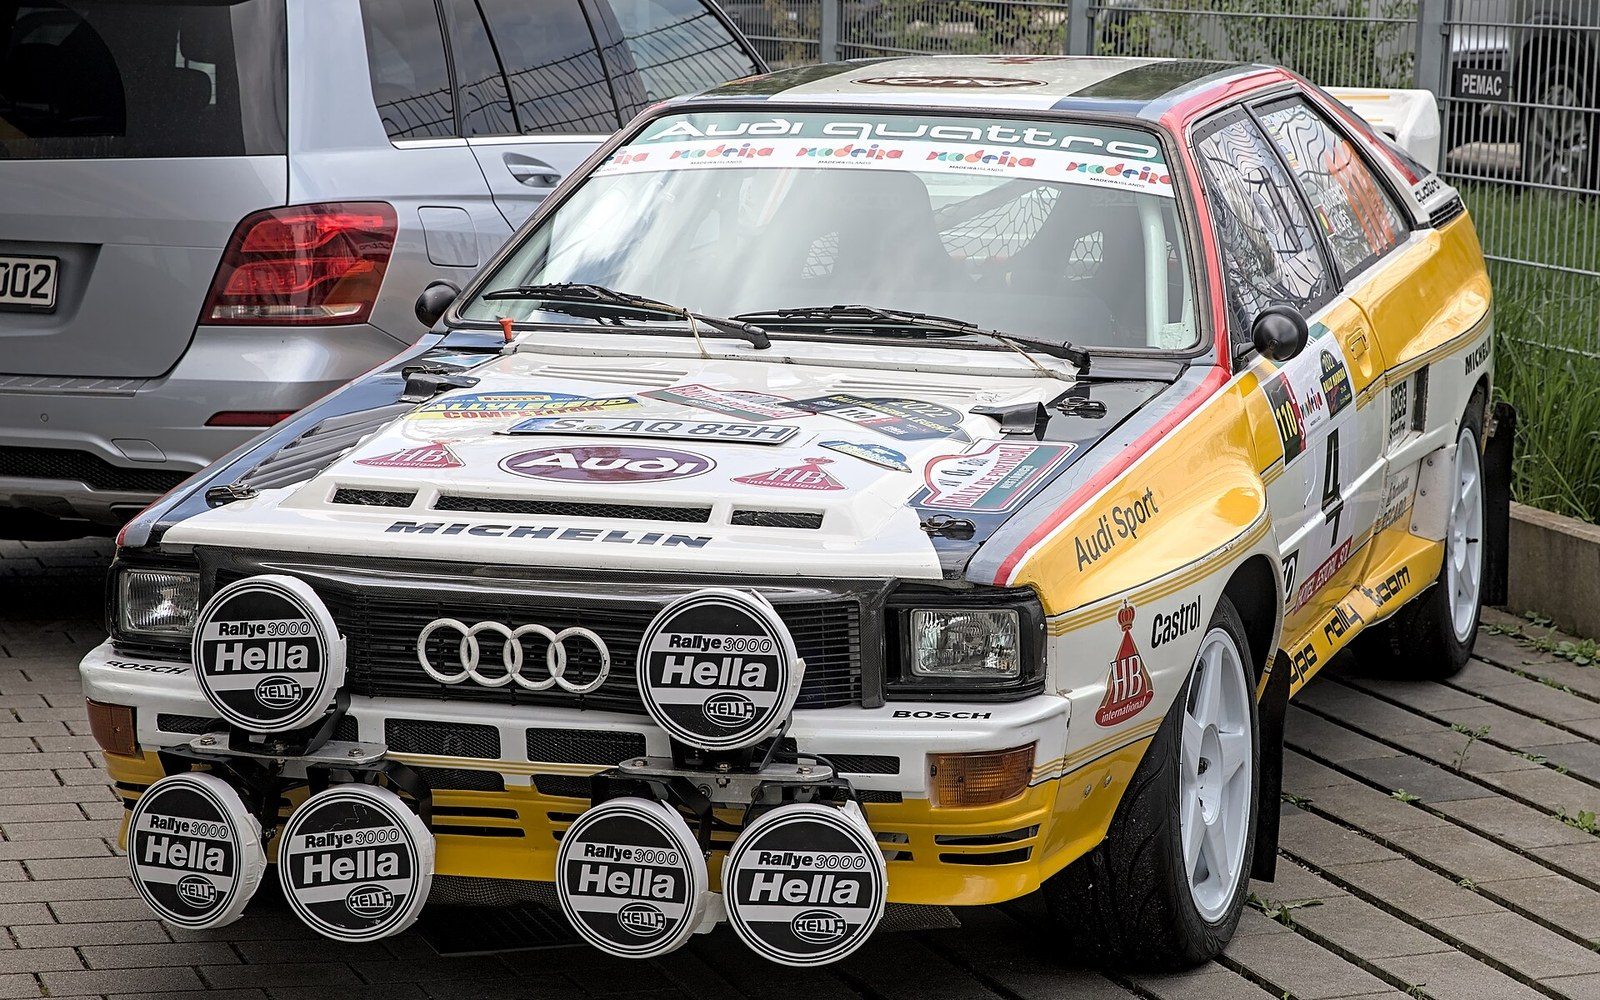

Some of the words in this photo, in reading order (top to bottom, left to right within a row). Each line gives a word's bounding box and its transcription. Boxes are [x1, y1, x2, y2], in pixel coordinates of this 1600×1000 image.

[1461, 74, 1503, 96] PEMAC
[647, 118, 804, 141] Audi
[822, 121, 1158, 158] quattro
[1415, 180, 1440, 204] quattro
[545, 420, 585, 430] S
[610, 420, 679, 434] AQ
[688, 423, 793, 440] 85H
[1276, 401, 1298, 441] 110
[388, 449, 449, 463] HB
[514, 453, 699, 474] Audi
[766, 468, 827, 484] HB
[934, 486, 989, 506] RALLY
[987, 447, 1034, 476] PORTUGAL
[1321, 427, 1344, 548] 4
[384, 521, 713, 549] MICHELIN
[1074, 514, 1115, 572] Audi
[1112, 487, 1159, 540] Sport
[218, 622, 266, 638] Rallye
[268, 621, 311, 636] 3000
[1151, 595, 1201, 649] Castrol
[1324, 603, 1365, 646] rally
[669, 634, 722, 651] Rallye
[723, 637, 772, 653] 3000
[105, 660, 190, 675] BOSCH
[215, 641, 309, 672] Hella
[661, 655, 768, 688] Hella
[1110, 654, 1143, 703] HB
[259, 684, 302, 699] HELLA
[706, 702, 756, 718] HELLA
[892, 710, 992, 720] BOSCH
[1101, 698, 1146, 723] international
[149, 815, 190, 835] Rallye
[190, 822, 228, 839] 3000
[305, 832, 353, 849] Rallye
[355, 828, 399, 844] 3000
[144, 835, 225, 872] Hella
[583, 844, 632, 862] Rallye
[634, 849, 678, 865] 3000
[757, 851, 813, 868] Rallye
[815, 855, 866, 870] 3000
[303, 850, 399, 885] Hella
[180, 883, 217, 900] HELLA
[578, 864, 675, 899] Hella
[749, 872, 861, 904] Hella
[349, 891, 395, 908] HELLA
[620, 910, 665, 929] HELLA
[794, 919, 847, 935] HELLA
